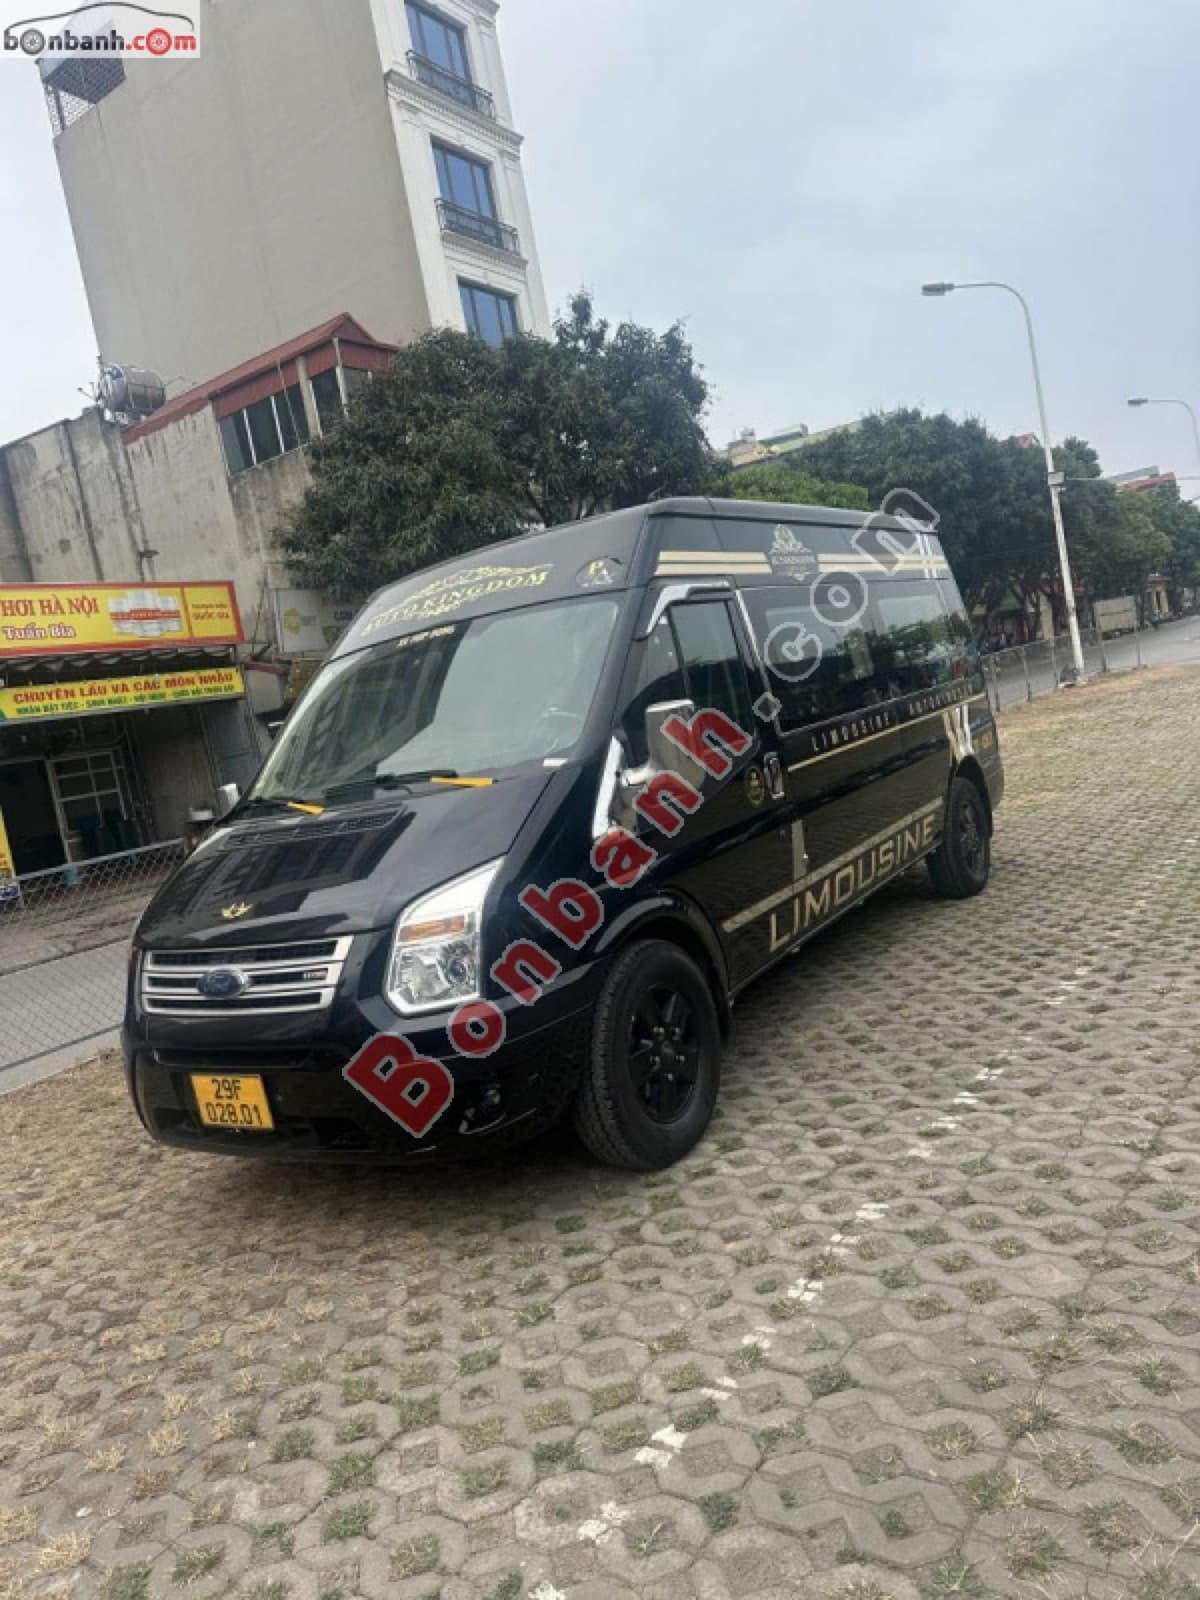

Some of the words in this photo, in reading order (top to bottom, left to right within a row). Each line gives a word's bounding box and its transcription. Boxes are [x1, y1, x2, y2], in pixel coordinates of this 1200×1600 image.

[39, 593, 66, 616] HÀ
[66, 594, 100, 619] NỘI
[811, 711, 889, 752] LIMOUSINE
[769, 814, 935, 952] LIMOUSINE
[211, 1078, 241, 1101] 29F
[205, 1102, 263, 1126] 028.01
